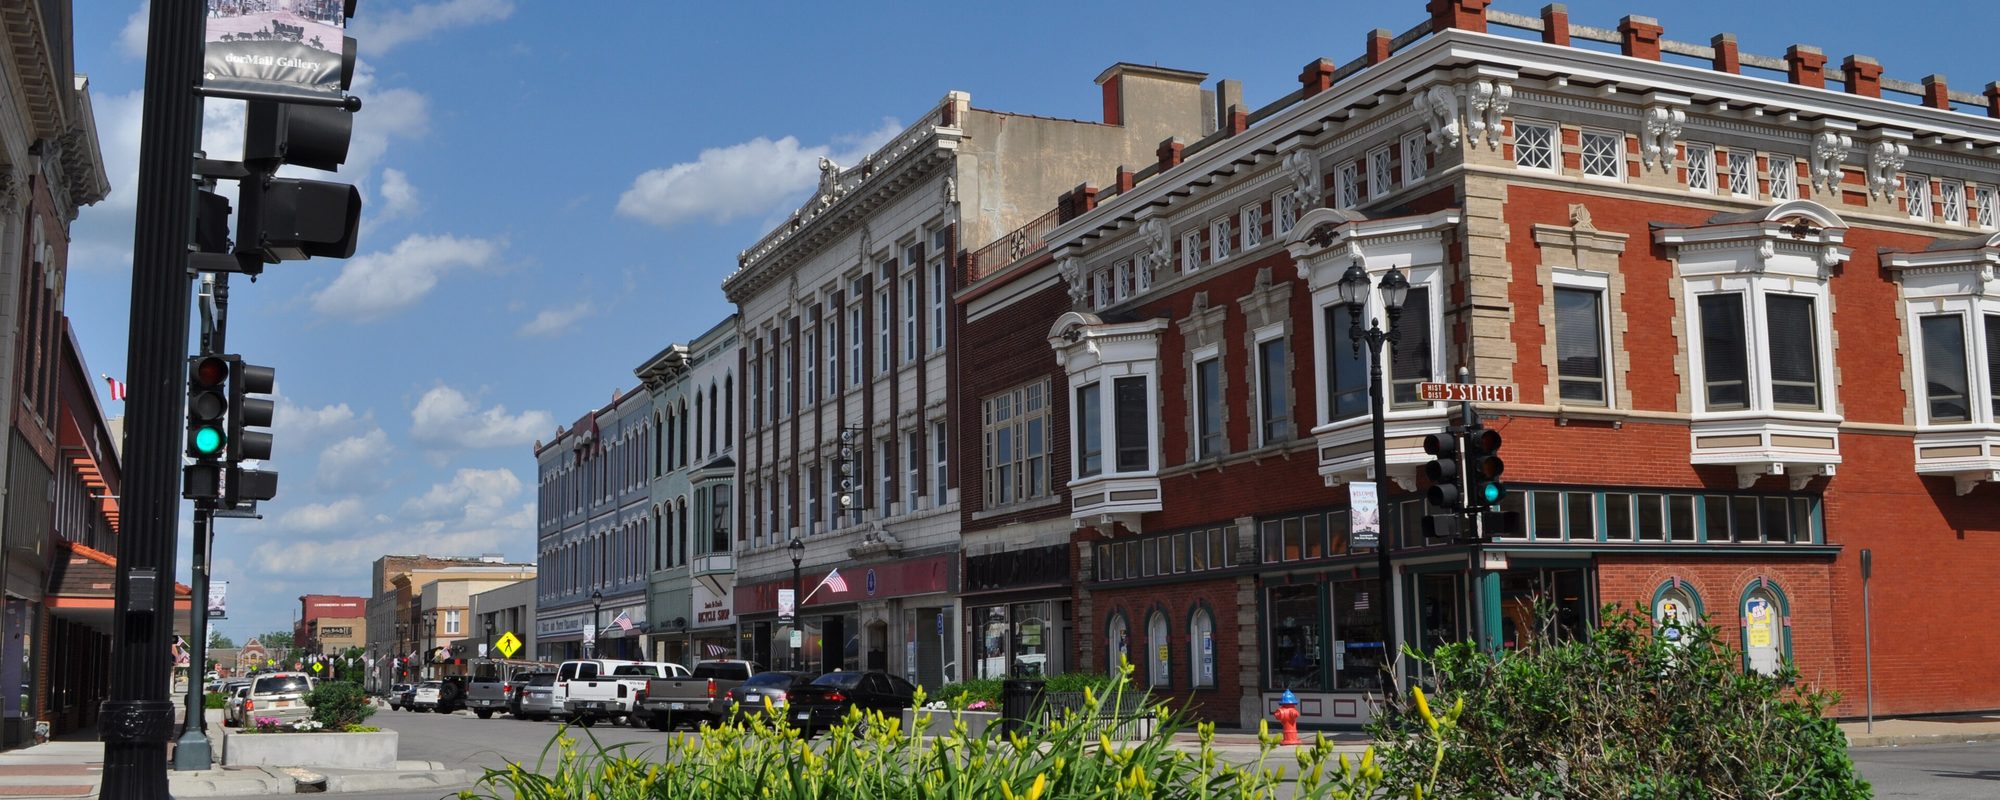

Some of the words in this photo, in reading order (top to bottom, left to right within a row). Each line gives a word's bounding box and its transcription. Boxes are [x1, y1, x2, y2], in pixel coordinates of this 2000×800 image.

[277, 57, 320, 72] Gallery
[1427, 391, 1442, 399] DIST
[1446, 384, 1458, 400] 5TH
[1460, 385, 1507, 401] STREET
[698, 610, 716, 623] BICYCLE
[717, 608, 730, 621] SHOP
